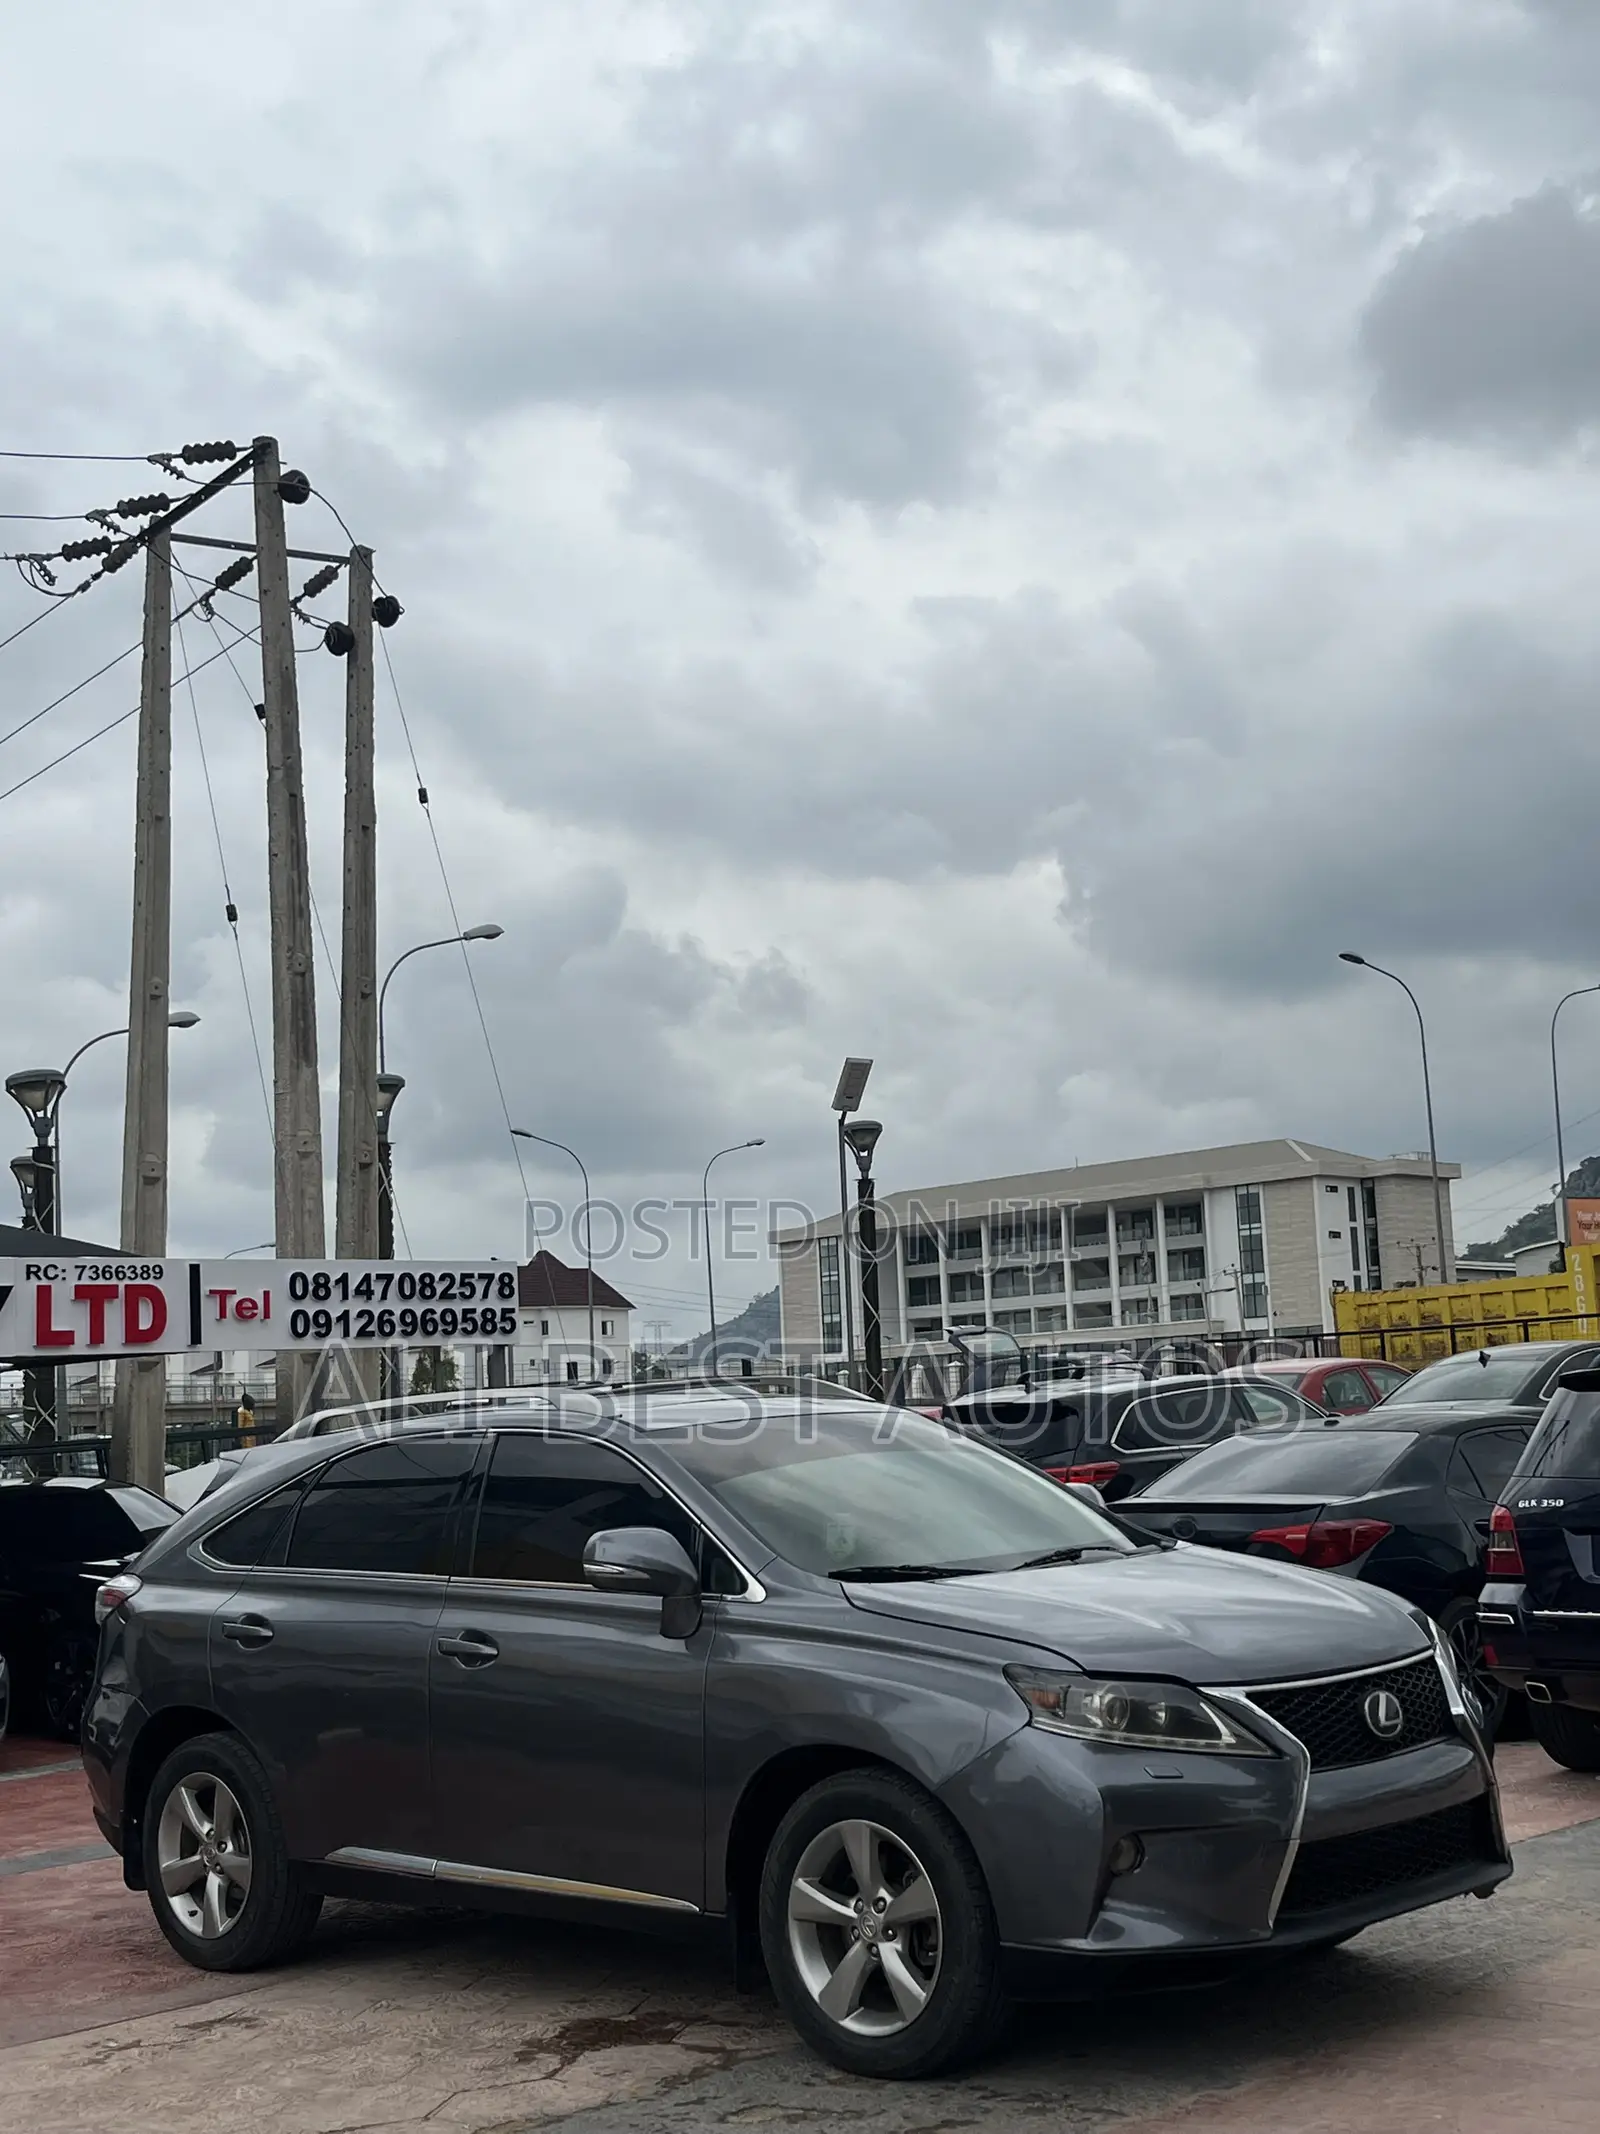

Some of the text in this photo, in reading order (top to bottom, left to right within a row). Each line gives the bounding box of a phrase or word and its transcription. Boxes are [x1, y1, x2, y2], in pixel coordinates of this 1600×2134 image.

[25, 1263, 164, 1281] RC: 7366389
[288, 1271, 516, 1301] 08147082578
[36, 1284, 168, 1346] LTD
[208, 1289, 271, 1320] Tel
[290, 1307, 517, 1338] 09126969585
[1518, 1499, 1564, 1508] GLK 350
